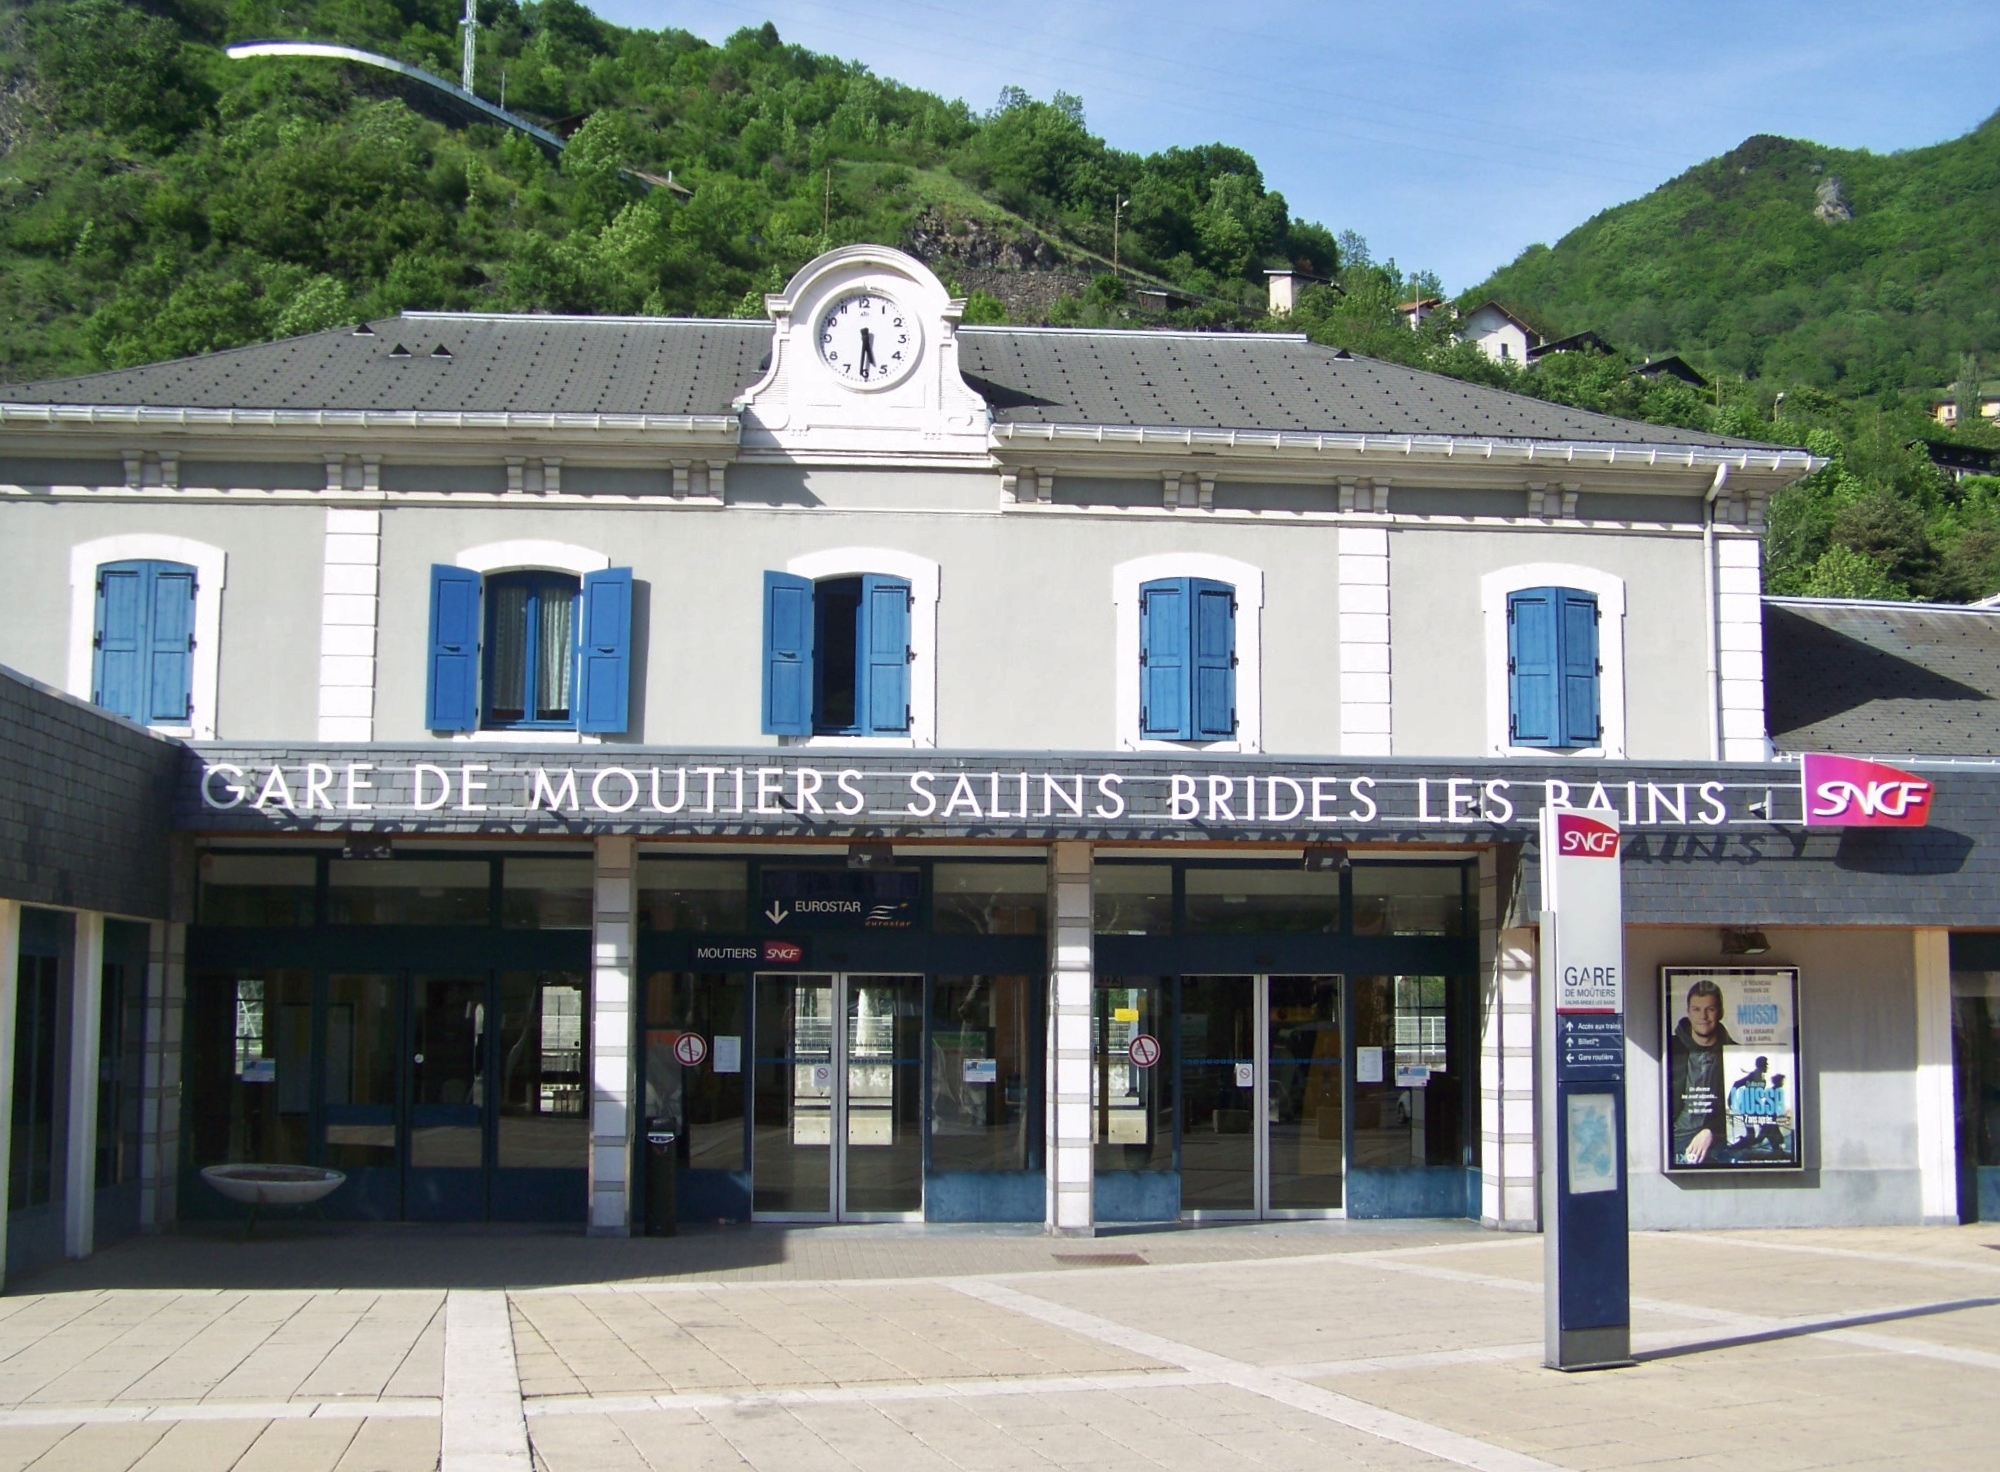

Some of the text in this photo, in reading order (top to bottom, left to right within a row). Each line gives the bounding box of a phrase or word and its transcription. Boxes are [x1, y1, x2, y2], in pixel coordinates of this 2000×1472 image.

[859, 298, 870, 308] 12
[840, 305, 847, 314] 11
[881, 305, 885, 314] 1
[827, 317, 837, 327] 10
[893, 317, 902, 327] 2
[823, 333, 832, 343] 9
[897, 334, 906, 343] 3
[829, 351, 838, 360] 8
[891, 351, 901, 360] 4
[843, 364, 851, 373] 7
[879, 365, 887, 374] 5
[202, 763, 1726, 826] GARE DE MOUTIERS SALINS BRIDES LES BAINS
[1812, 781, 1928, 816] SNCF
[1562, 831, 1618, 852] SNCF
[795, 901, 861, 912] EUROSTAR
[697, 948, 800, 958] MOUTIERS SNCF
[1564, 966, 1616, 986] GARE
[1565, 987, 1616, 997] DE MOÛTIERS
[1737, 1004, 1778, 1025] MUSSO
[1578, 1022, 1594, 1030] Accès
[1605, 1022, 1621, 1030] trains
[1578, 1053, 1614, 1061] Gare routière
[1730, 1086, 1785, 1116] MUSSO
[1744, 1115, 1748, 1123] 7
